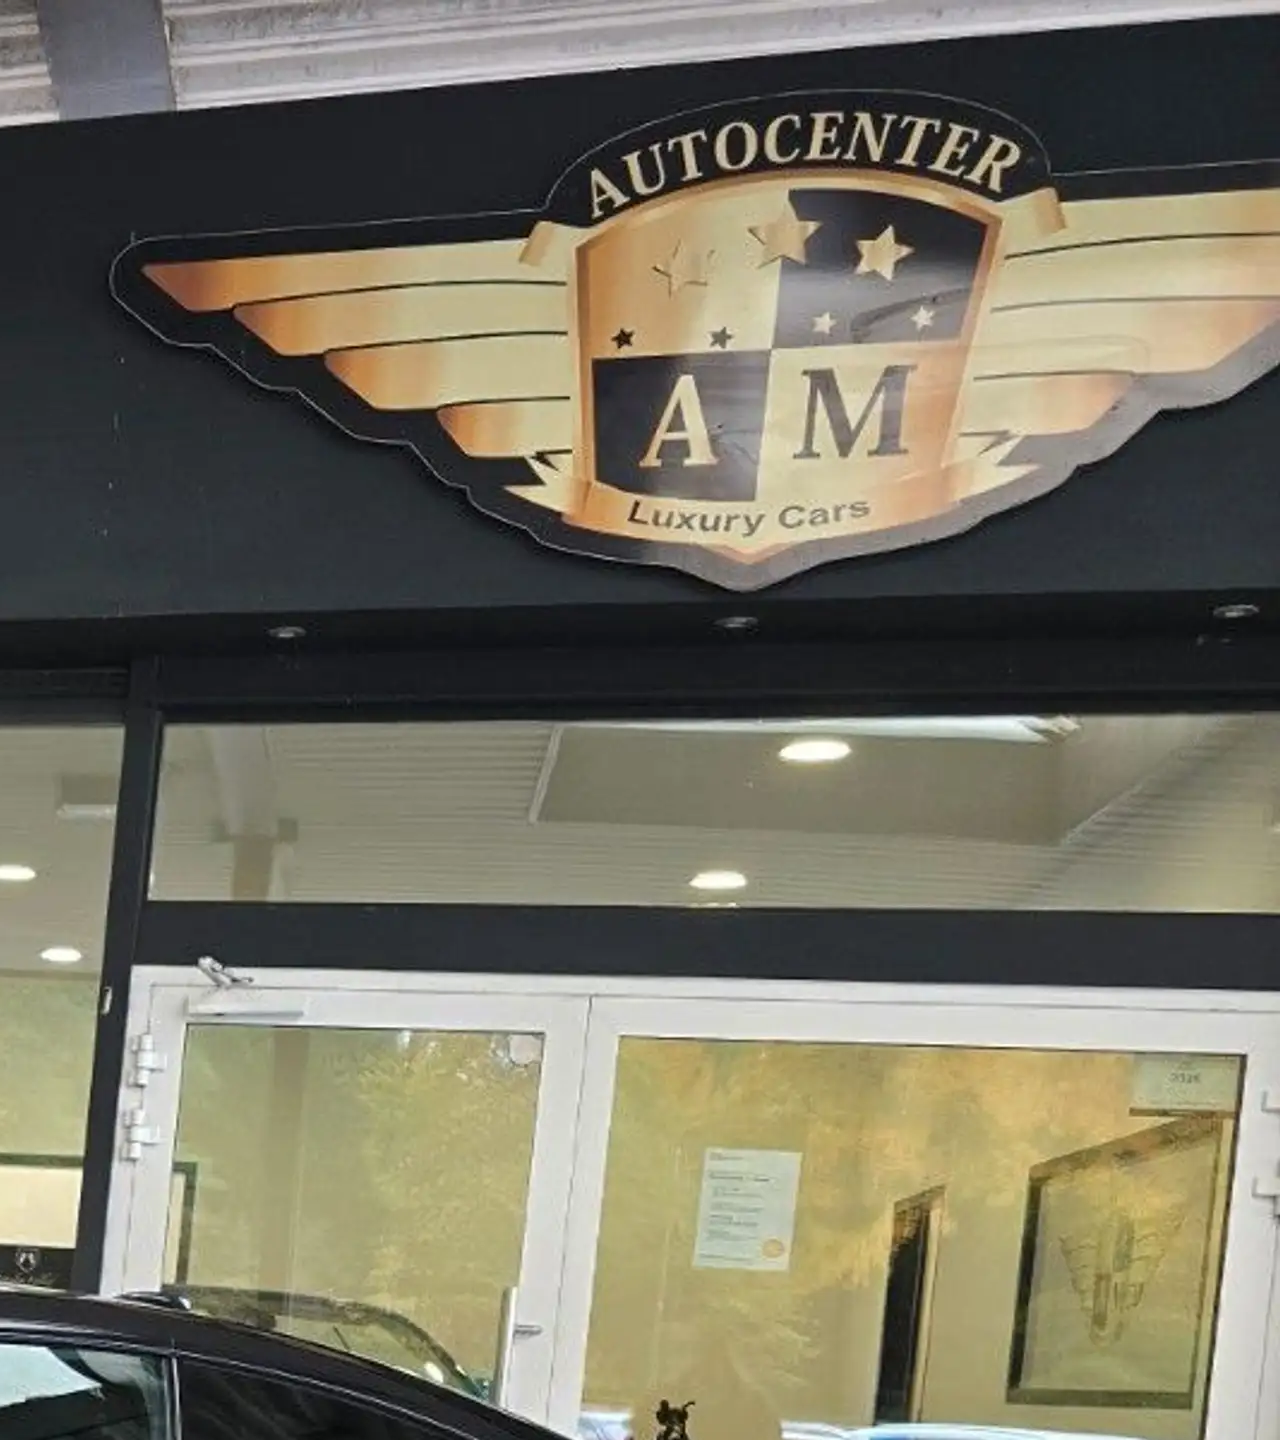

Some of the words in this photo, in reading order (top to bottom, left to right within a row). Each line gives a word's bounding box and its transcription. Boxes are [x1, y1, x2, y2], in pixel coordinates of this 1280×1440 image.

[590, 110, 1021, 219] AUTOCENTER
[639, 373, 719, 468] A
[792, 364, 919, 460] M
[627, 500, 766, 538] Luxury
[778, 500, 872, 530] Cars
